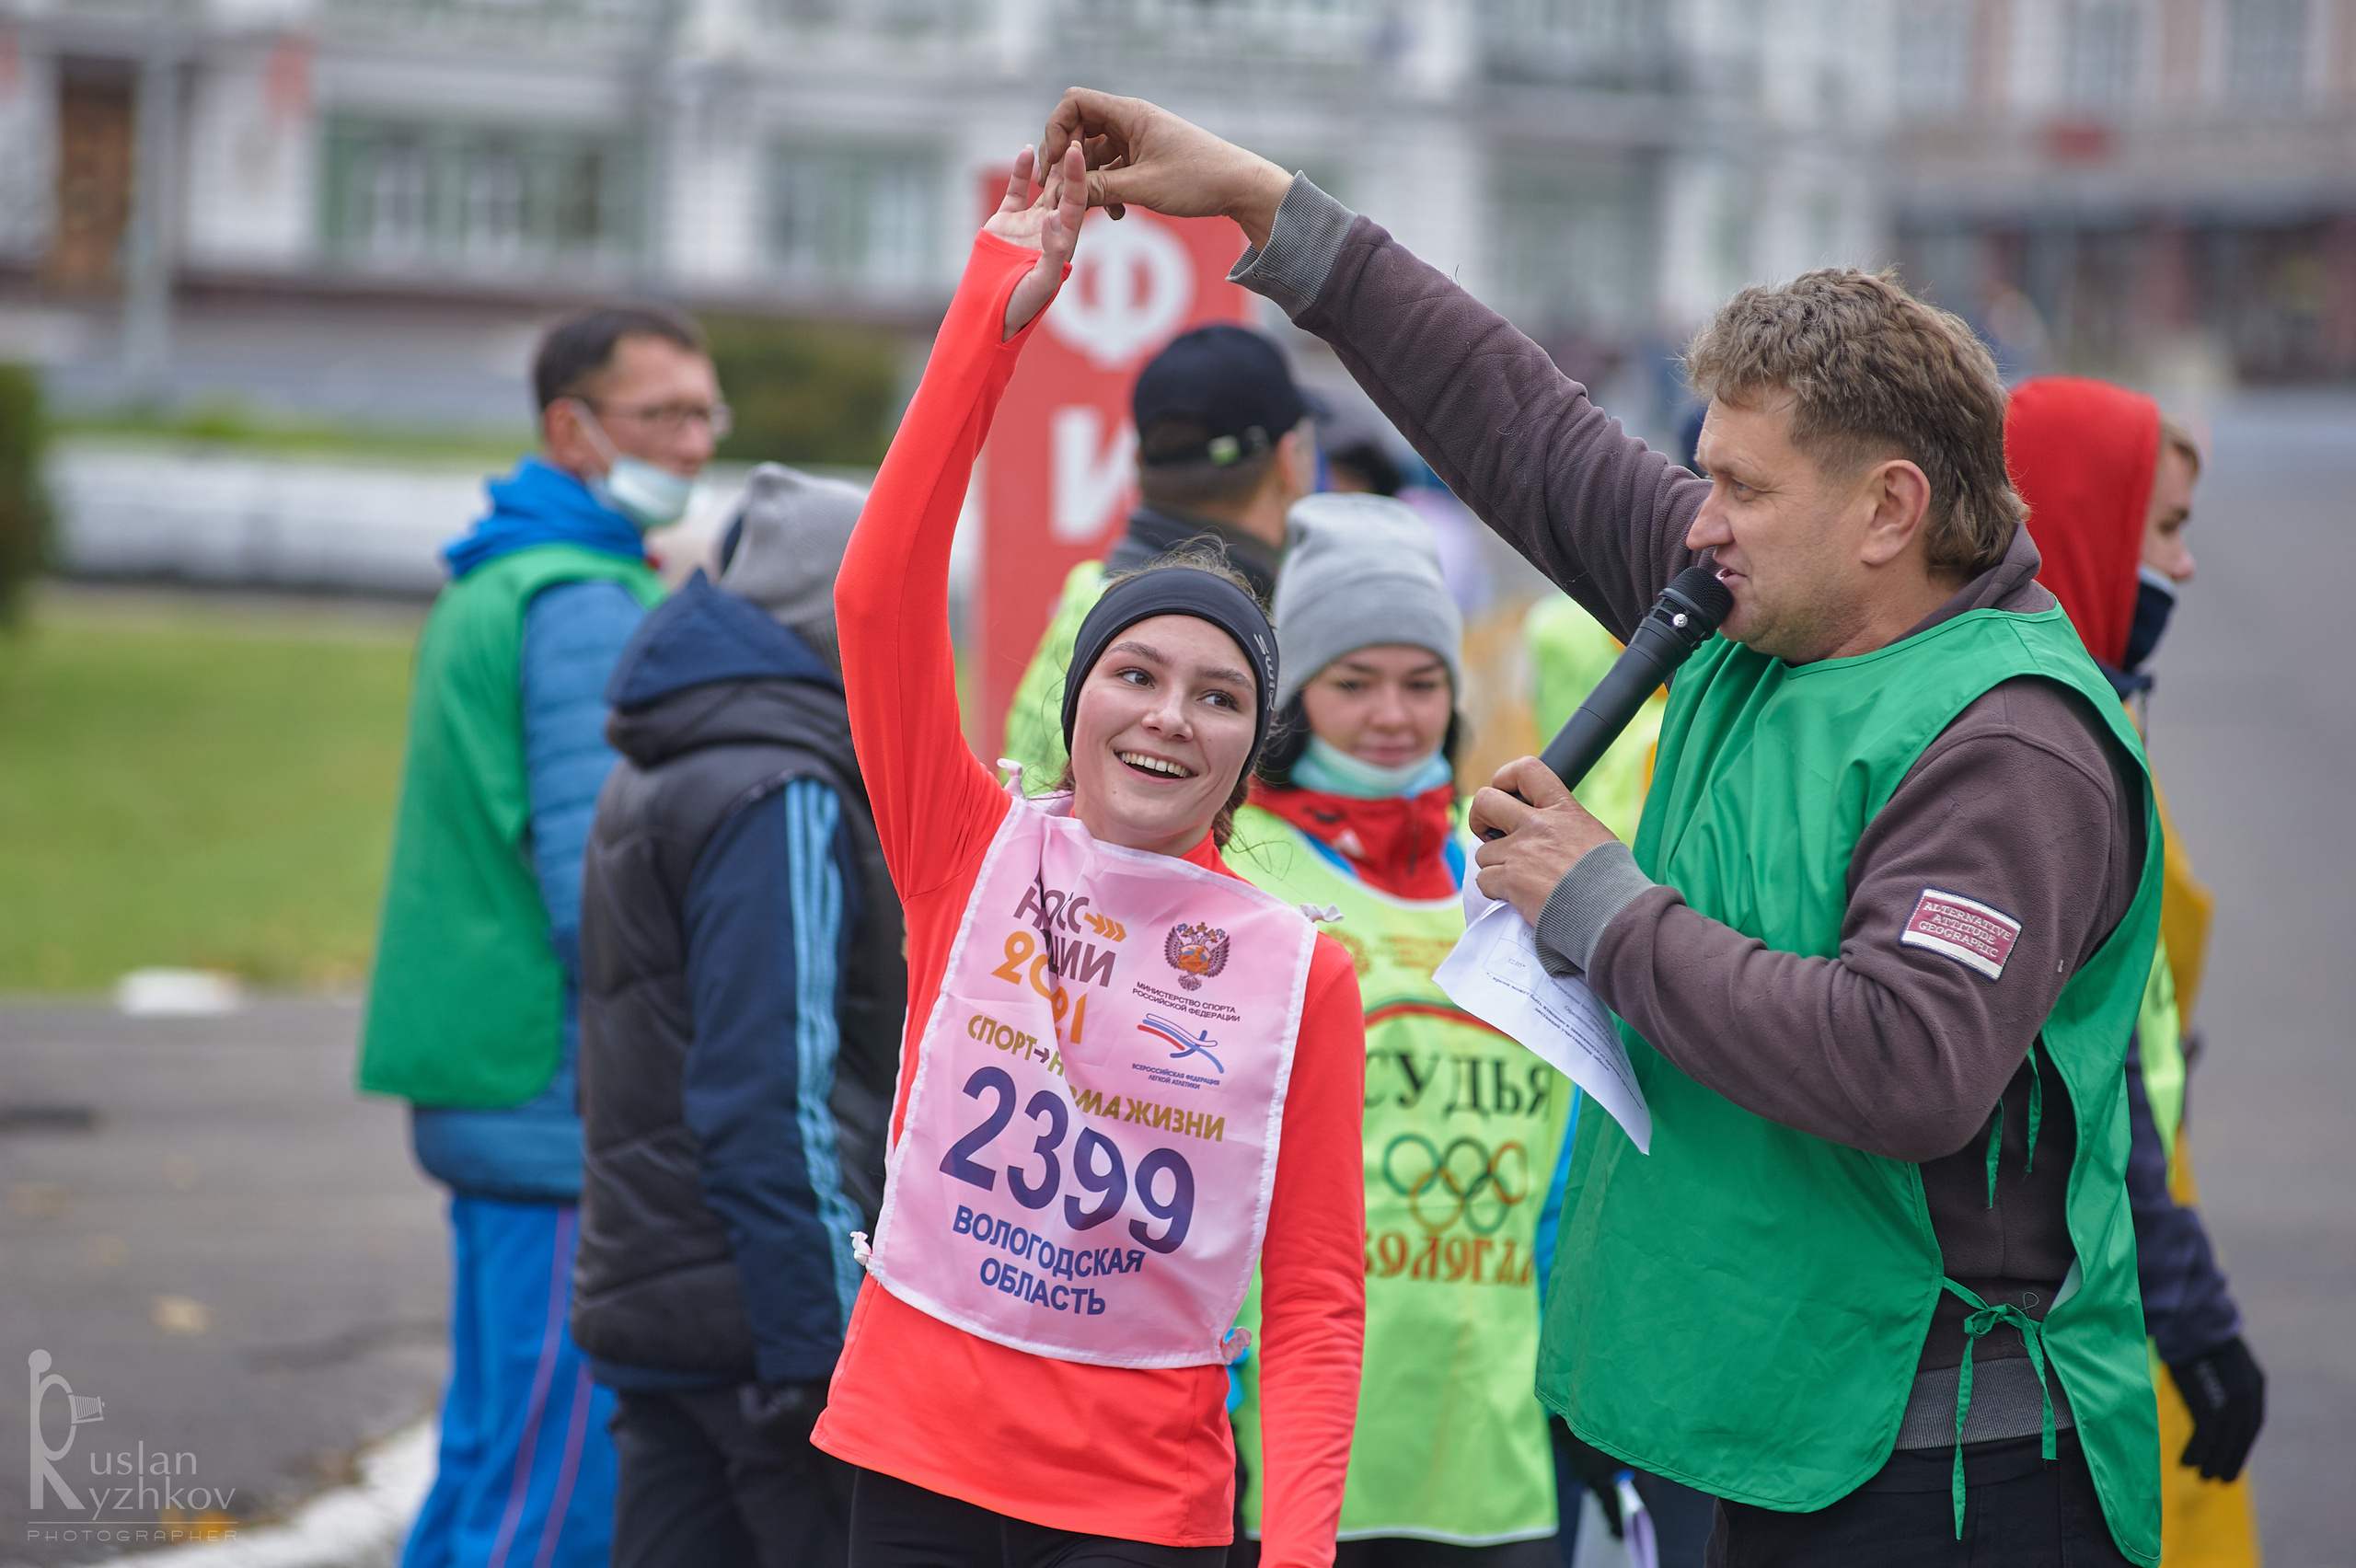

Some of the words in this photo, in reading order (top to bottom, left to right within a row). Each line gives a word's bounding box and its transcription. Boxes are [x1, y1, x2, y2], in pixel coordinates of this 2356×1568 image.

[1918, 920, 1999, 958] GEOGRAPHIC
[1923, 901, 2013, 940] ALTERNATIVE
[1933, 914, 1997, 945] ATTITUDE
[1132, 987, 1187, 1012] РОССИЙСКОЙ
[1188, 1007, 1241, 1022] ФЕДЕРАЦИИ
[1136, 981, 1201, 1008] МИНИСТЕРСТВО
[1202, 1001, 1236, 1014] СПОРТА
[967, 1014, 1037, 1061] СПОРТ
[1123, 1097, 1226, 1142] ЖИЗНИ
[1131, 1063, 1185, 1079] ВСЕРОССИЙСКАЯ
[1185, 1074, 1220, 1086] ФЕДЕРАЦИЯ
[1148, 1074, 1171, 1085] ЛЕГКОЙ
[1171, 1079, 1201, 1090] АТЛЕТИКИ
[939, 1066, 1195, 1254] 2399
[953, 1205, 1147, 1281] ВОЛОГОДСКАЯ
[979, 1257, 1106, 1316] ОБЛАСТЬ
